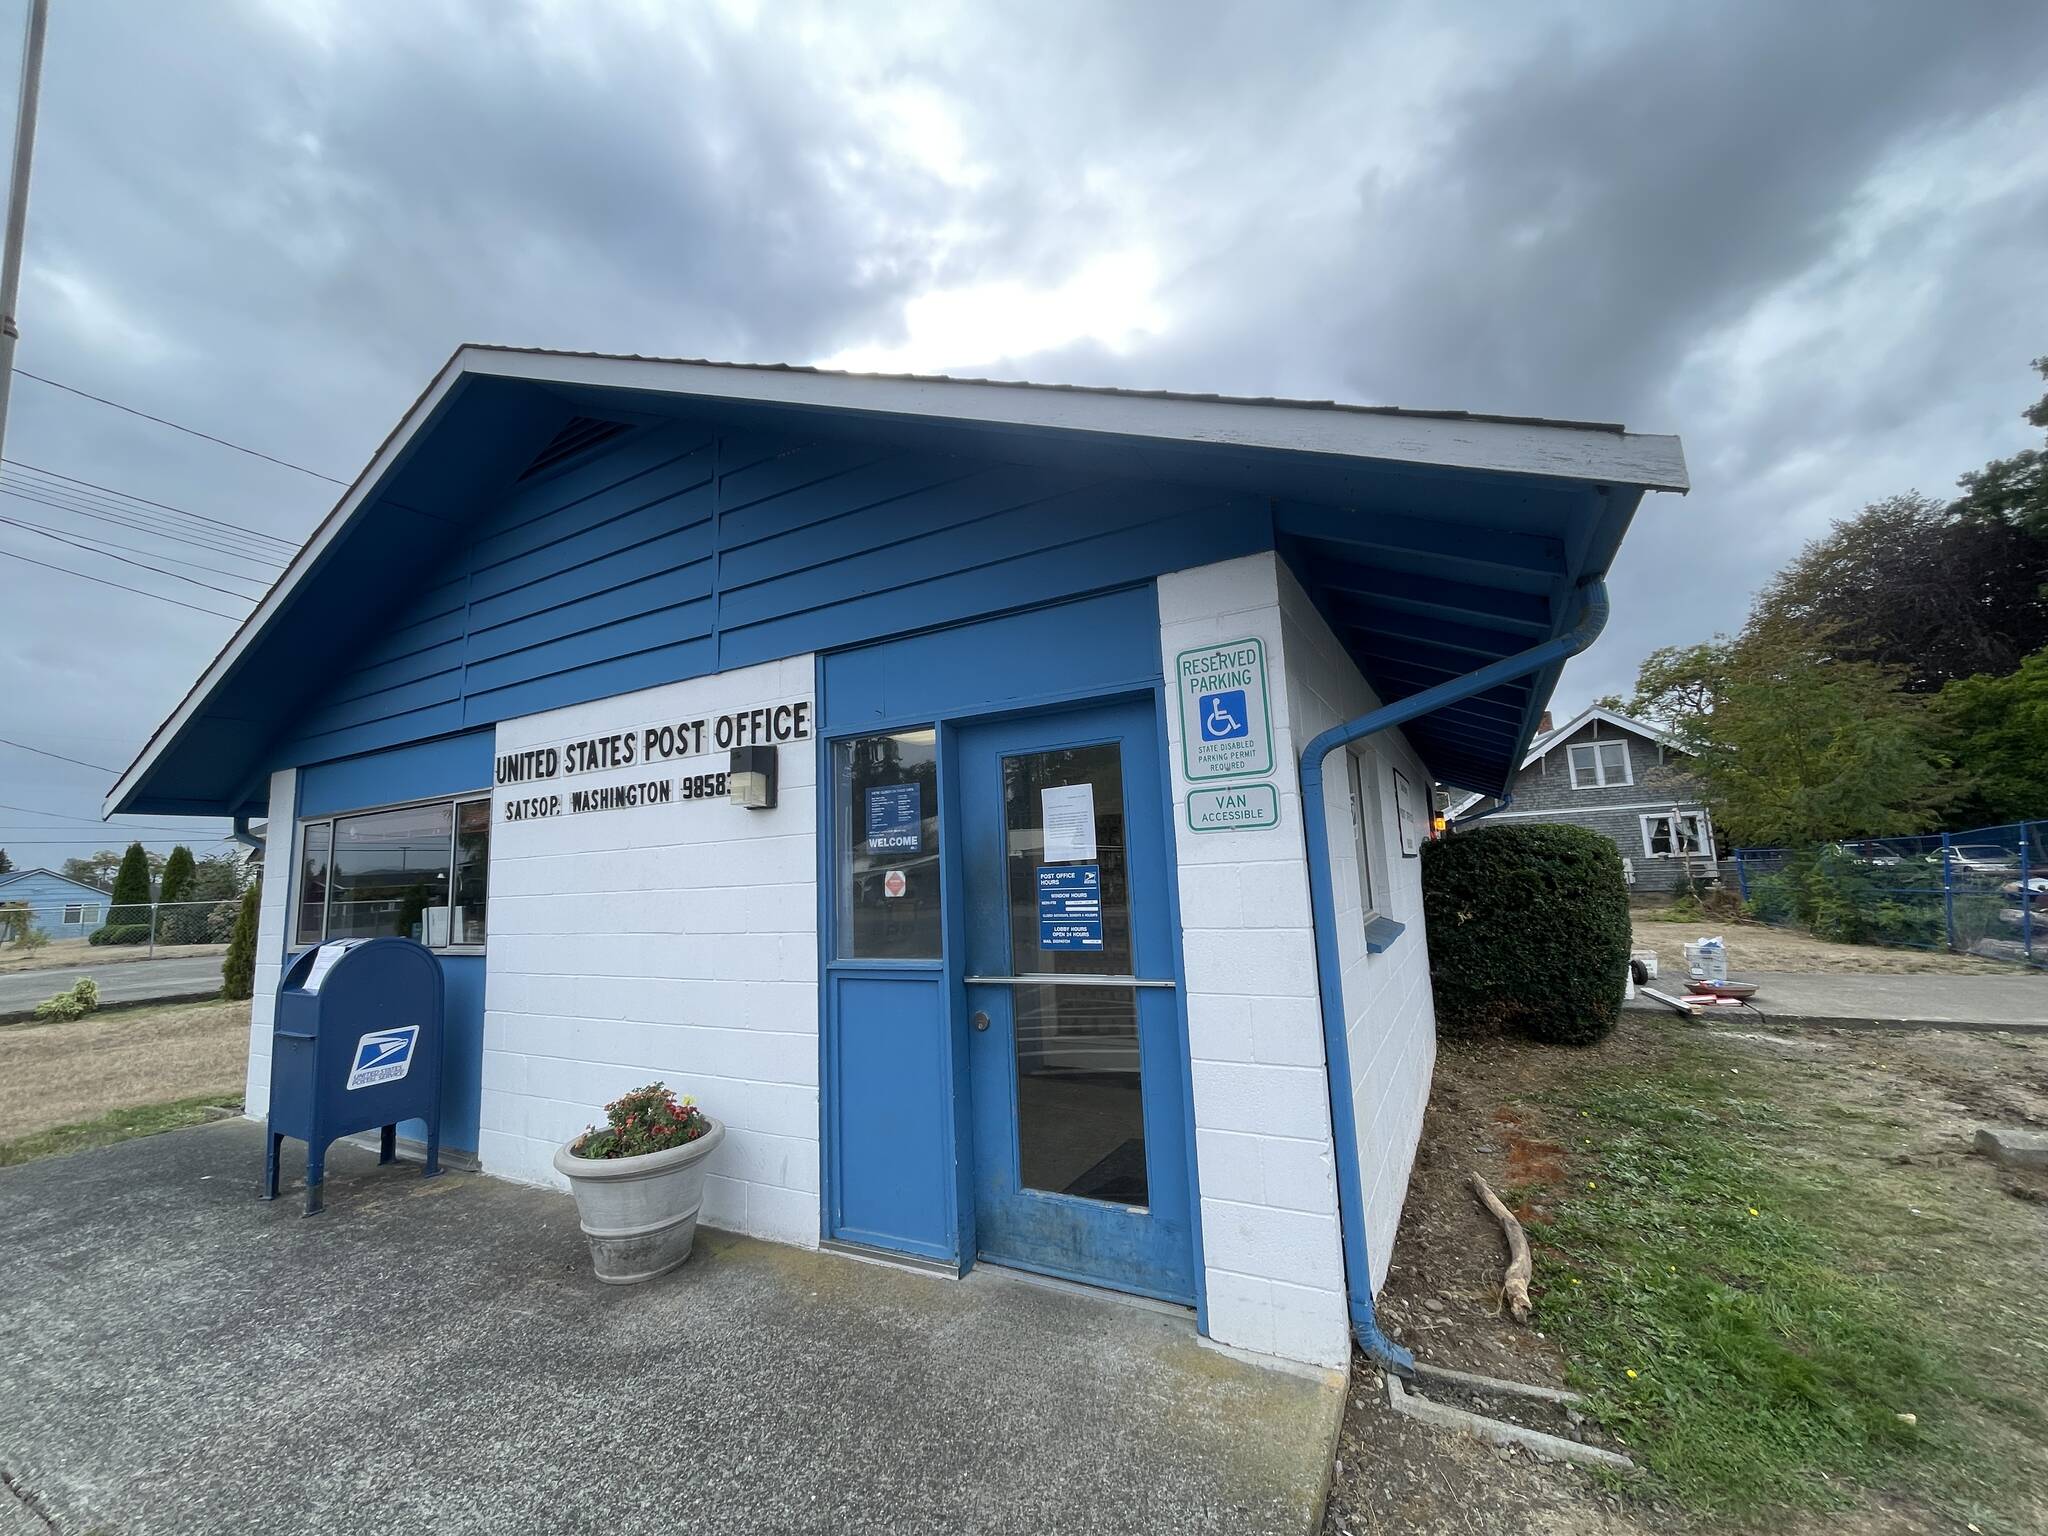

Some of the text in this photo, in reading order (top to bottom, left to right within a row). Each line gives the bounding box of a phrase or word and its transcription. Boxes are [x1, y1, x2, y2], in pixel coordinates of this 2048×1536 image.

[1183, 649, 1256, 676] RESERVED
[1190, 669, 1252, 694] PARKING
[496, 702, 809, 784] UNITED STATES POST OFFICE
[1198, 740, 1255, 754] STATE DISABLED
[1198, 750, 1256, 764] PARKING PERMIT
[1210, 761, 1245, 772] REQUIRED
[572, 780, 670, 812] WASHINGTON
[1215, 794, 1247, 809] VAN
[1201, 808, 1264, 823] ACCESSIBLE
[869, 835, 918, 848] WELCOME
[354, 1065, 403, 1080] UNITED STATES
